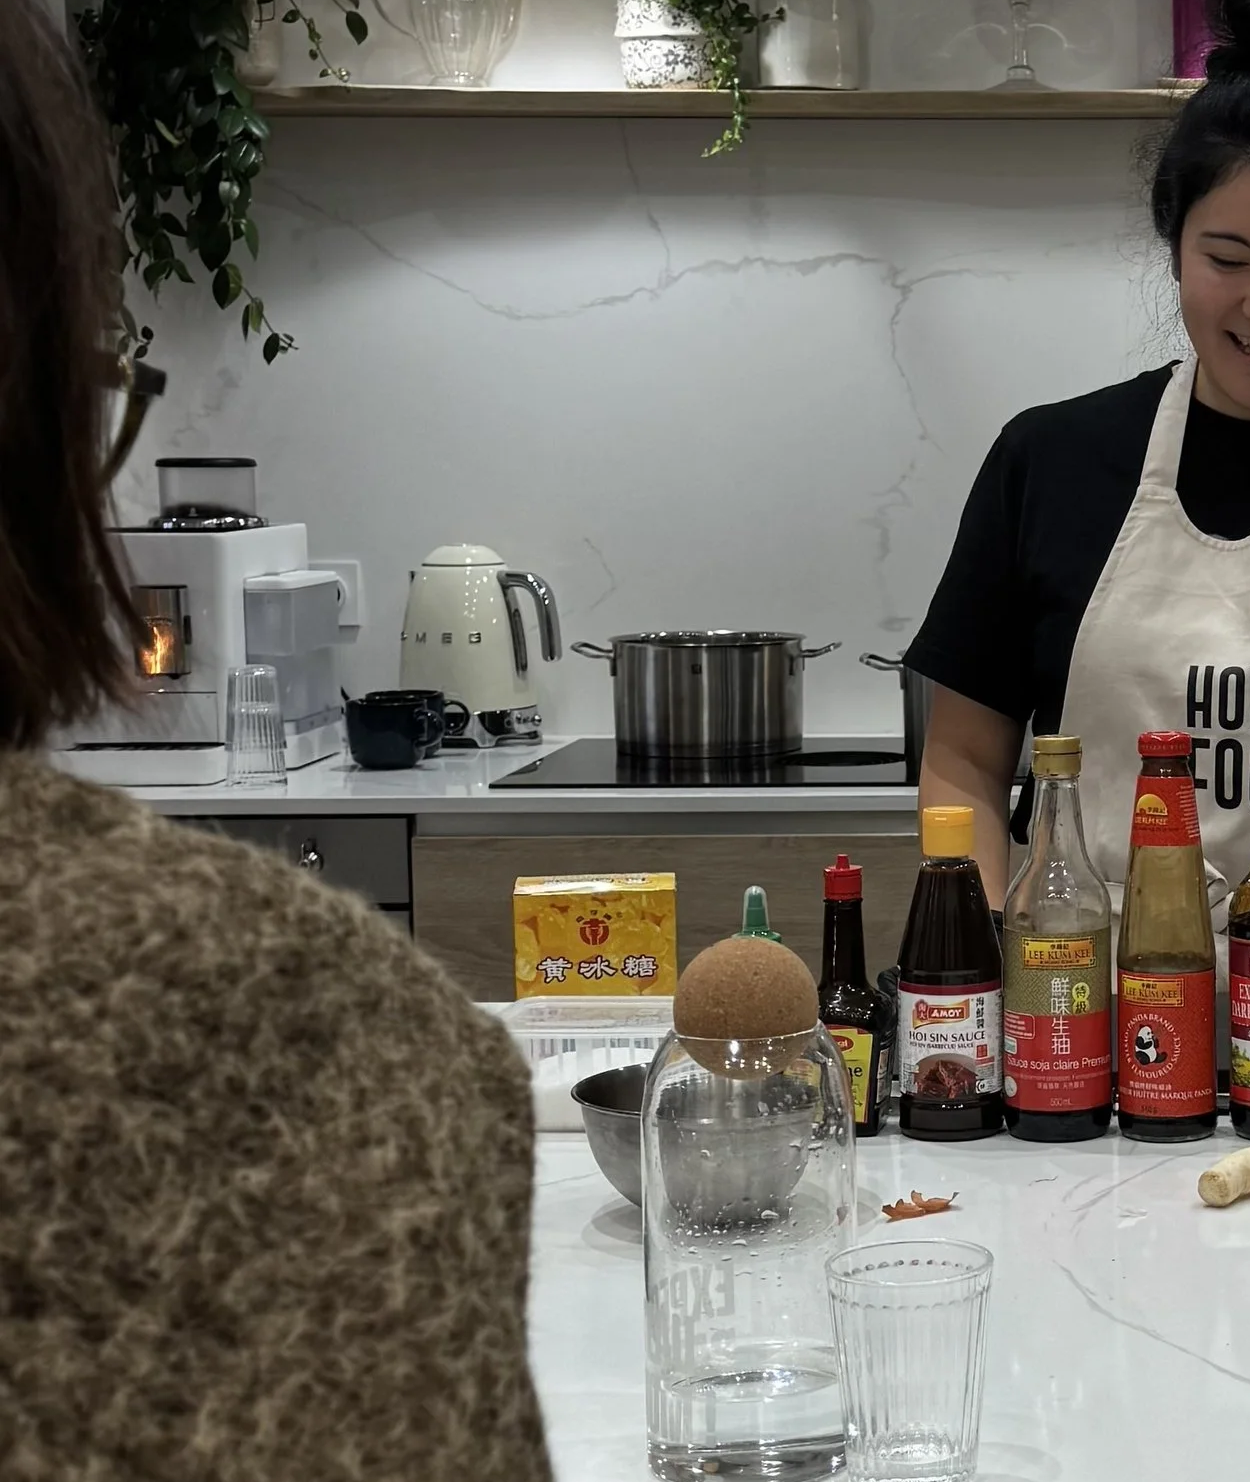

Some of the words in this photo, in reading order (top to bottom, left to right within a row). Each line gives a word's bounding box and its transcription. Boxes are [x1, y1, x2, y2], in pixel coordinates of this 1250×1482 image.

[1029, 950, 1044, 960] LEE
[1048, 950, 1071, 960] KUM
[1074, 949, 1091, 959] KEE
[1125, 986, 1137, 996] LEE
[1139, 989, 1159, 998] KUM
[1161, 990, 1178, 999] KEE
[931, 1008, 962, 1018] AMOY
[1051, 977, 1071, 1055] 鮮味生抽
[909, 1030, 927, 1040] HOI
[929, 1032, 948, 1043] SIN
[951, 1030, 985, 1042] SAUCE
[1007, 1054, 1028, 1069] Sauce
[1030, 1060, 1050, 1072] soja
[1053, 1059, 1079, 1070] claire
